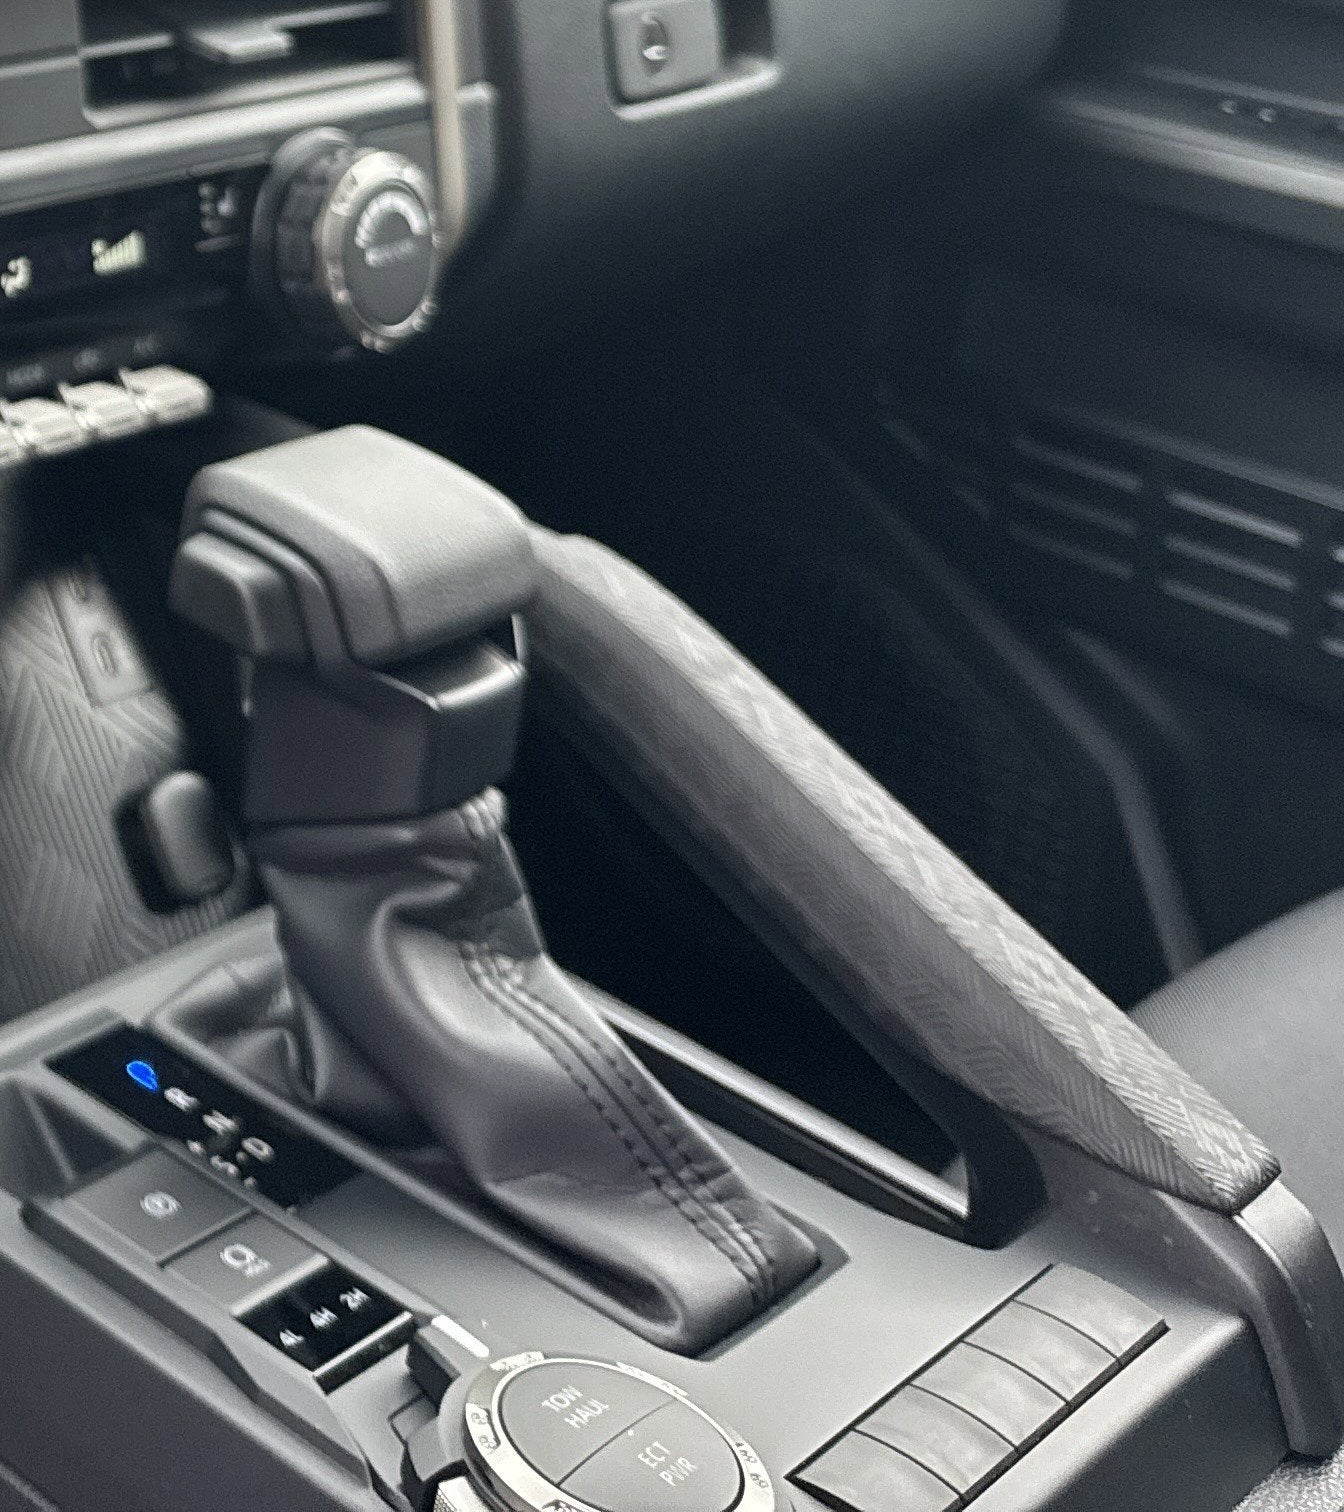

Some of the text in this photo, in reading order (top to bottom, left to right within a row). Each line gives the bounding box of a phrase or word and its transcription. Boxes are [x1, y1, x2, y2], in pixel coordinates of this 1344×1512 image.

[542, 1383, 584, 1414] TOW
[563, 1398, 610, 1430] HAUL
[636, 1439, 673, 1470] ECT
[658, 1455, 700, 1489] PWR
